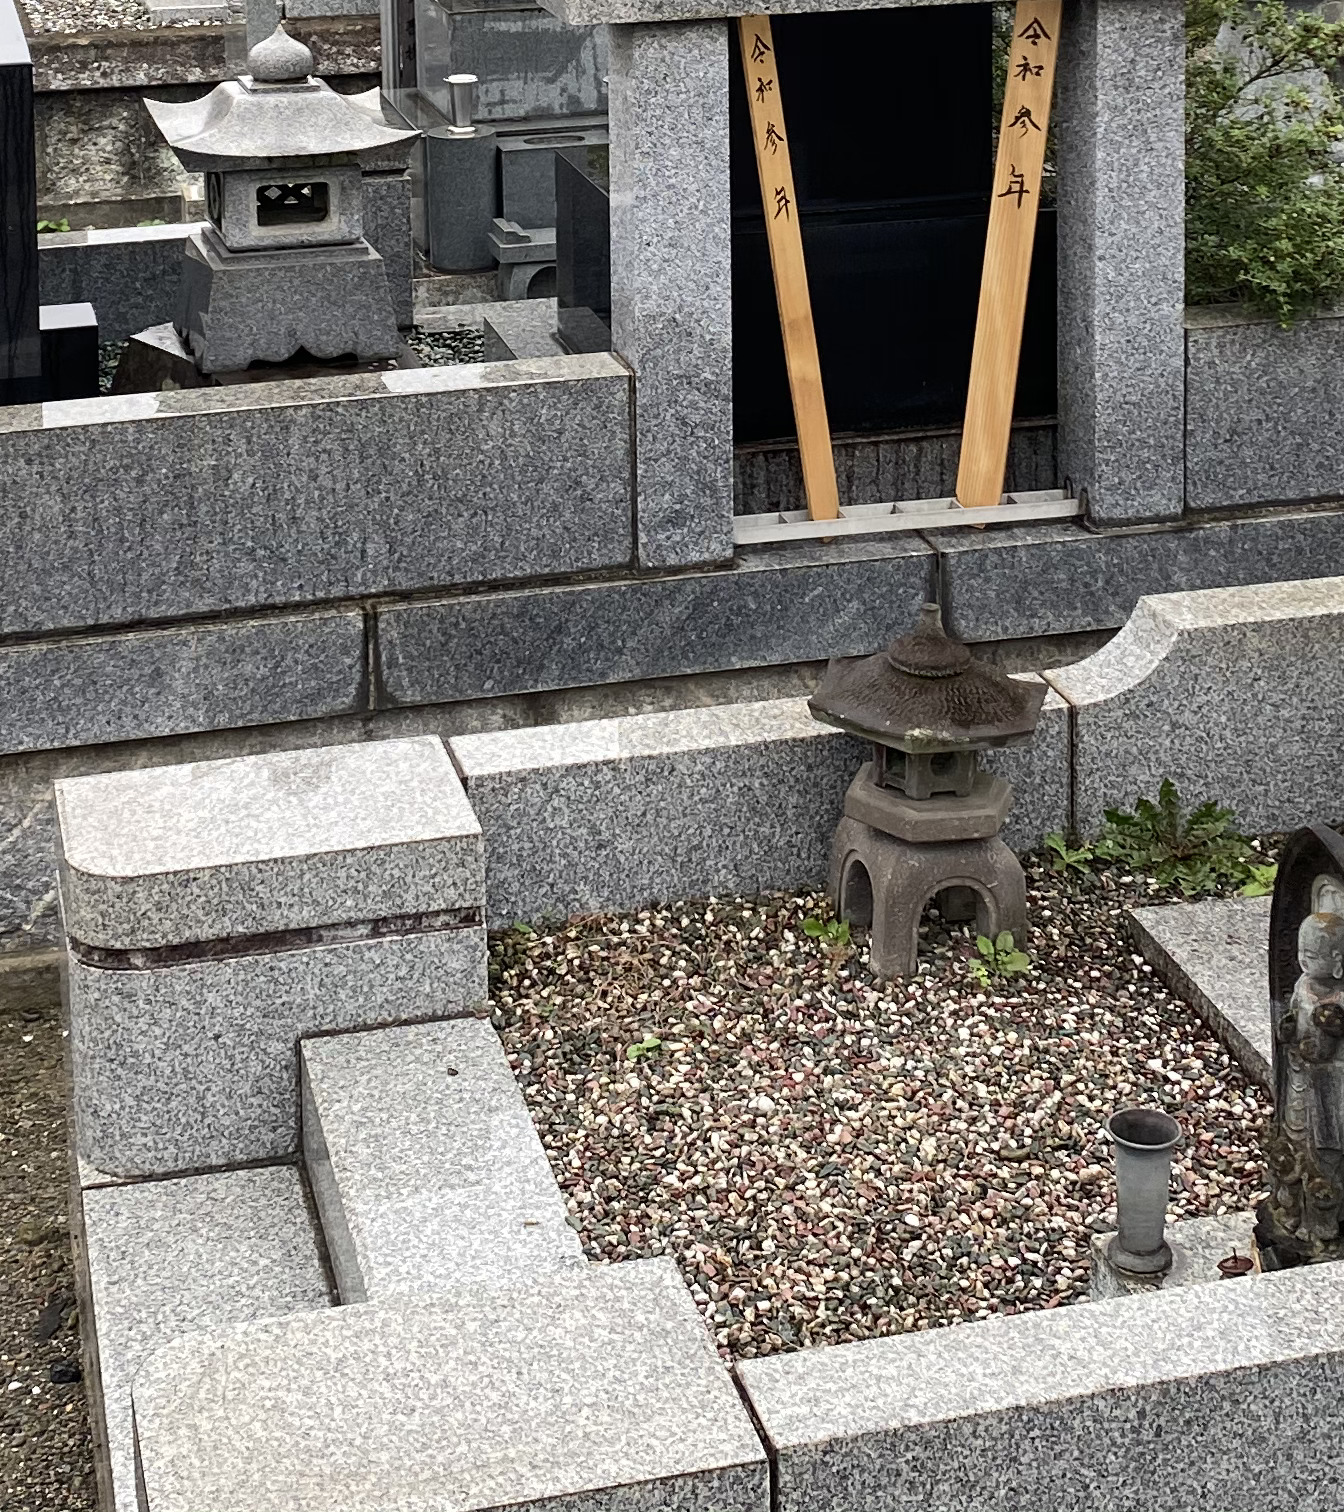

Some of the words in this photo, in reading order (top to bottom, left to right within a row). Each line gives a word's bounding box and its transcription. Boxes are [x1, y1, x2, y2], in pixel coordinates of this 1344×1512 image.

[750, 33, 792, 223] 令和参年
[997, 17, 1052, 210] 令和参年
